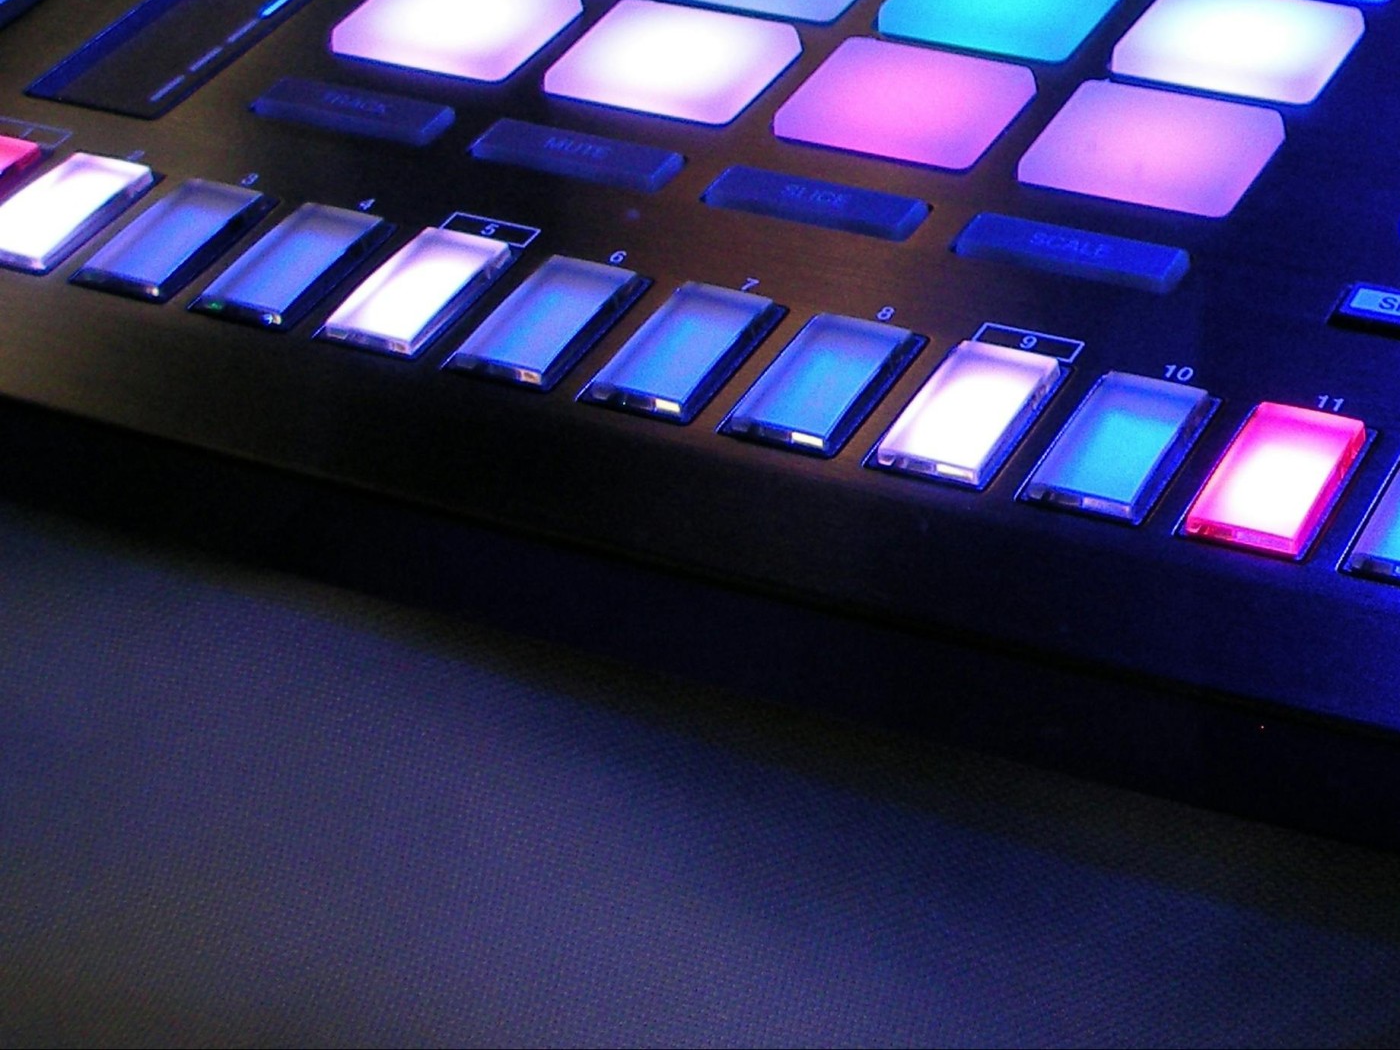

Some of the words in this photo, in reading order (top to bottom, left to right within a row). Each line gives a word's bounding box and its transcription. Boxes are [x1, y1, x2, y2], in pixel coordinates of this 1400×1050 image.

[609, 249, 628, 265] 6
[740, 277, 760, 292] 7
[876, 306, 896, 322] 8
[1018, 334, 1038, 350] 9
[1162, 363, 1195, 383] 10
[1316, 393, 1346, 413] 11
